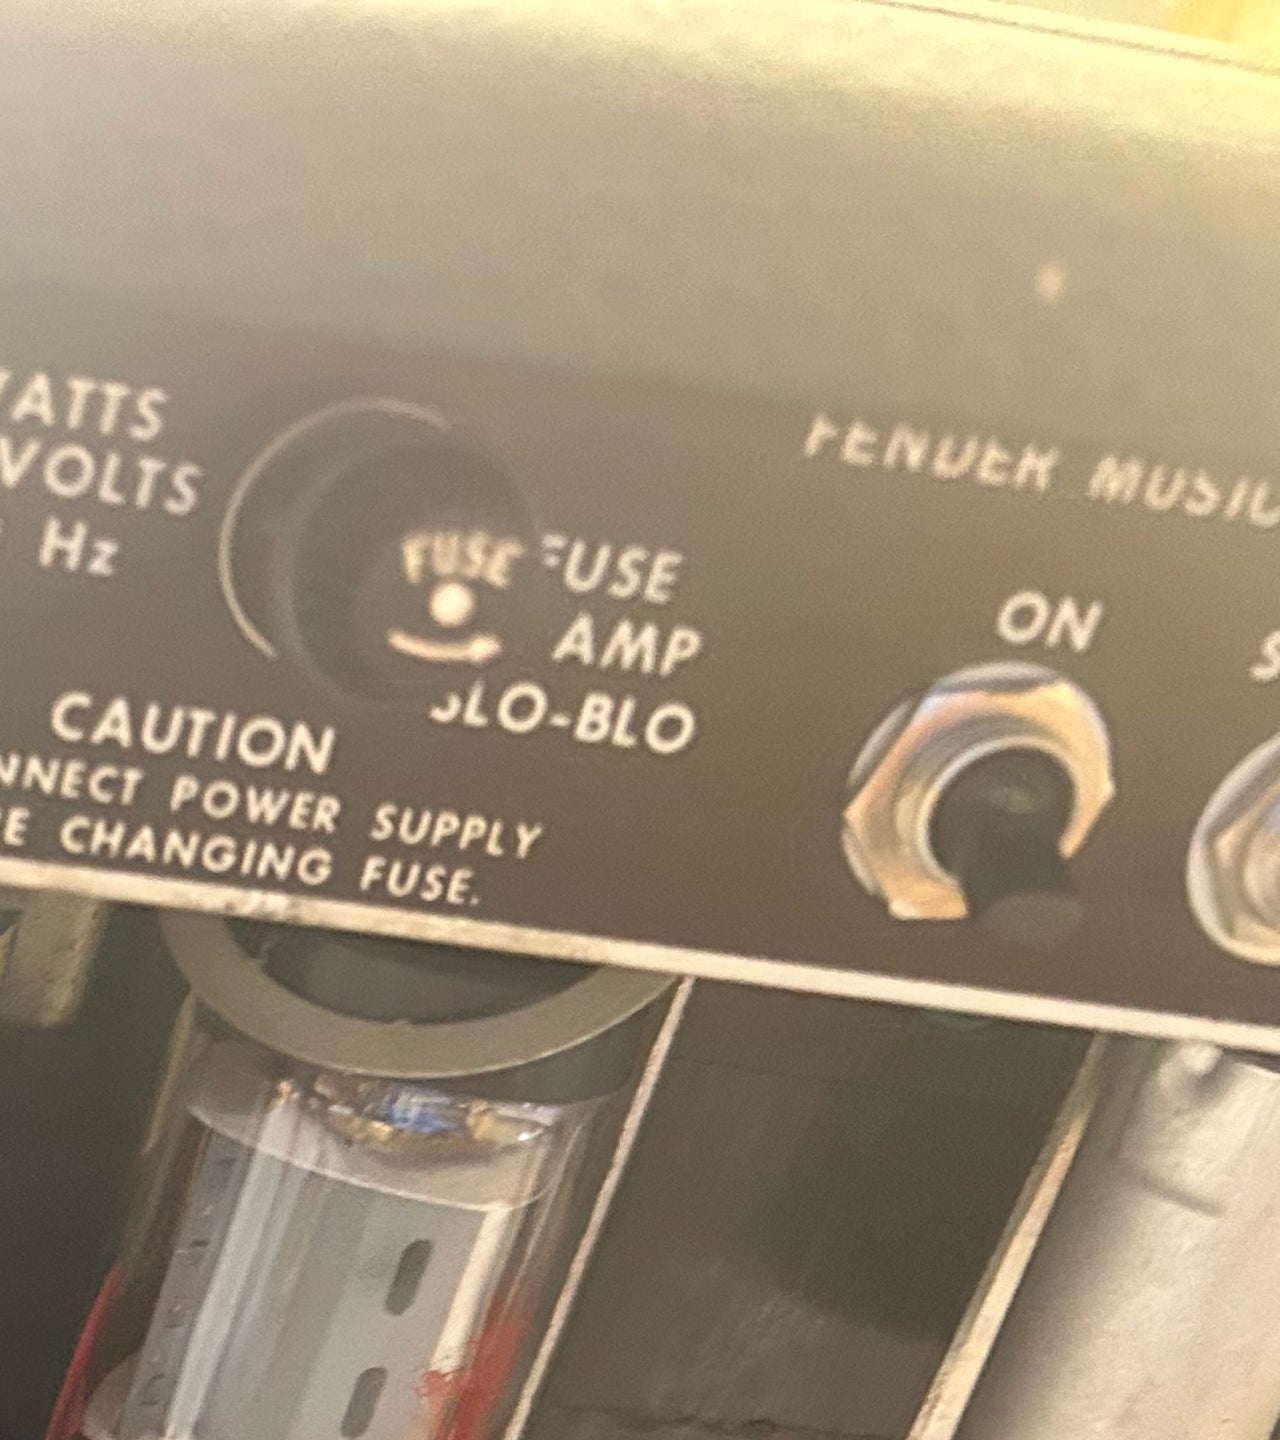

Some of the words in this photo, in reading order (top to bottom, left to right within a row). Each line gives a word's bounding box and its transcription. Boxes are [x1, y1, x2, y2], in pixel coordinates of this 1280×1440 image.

[39, 517, 120, 577] Hz
[551, 611, 702, 678] AMP
[996, 589, 1103, 652] ON
[50, 690, 336, 774] CAUTION
[170, 774, 341, 834] POWER
[369, 802, 542, 859] SUPPLY
[59, 814, 333, 886] CHANGING
[359, 855, 481, 906] FUSE.
